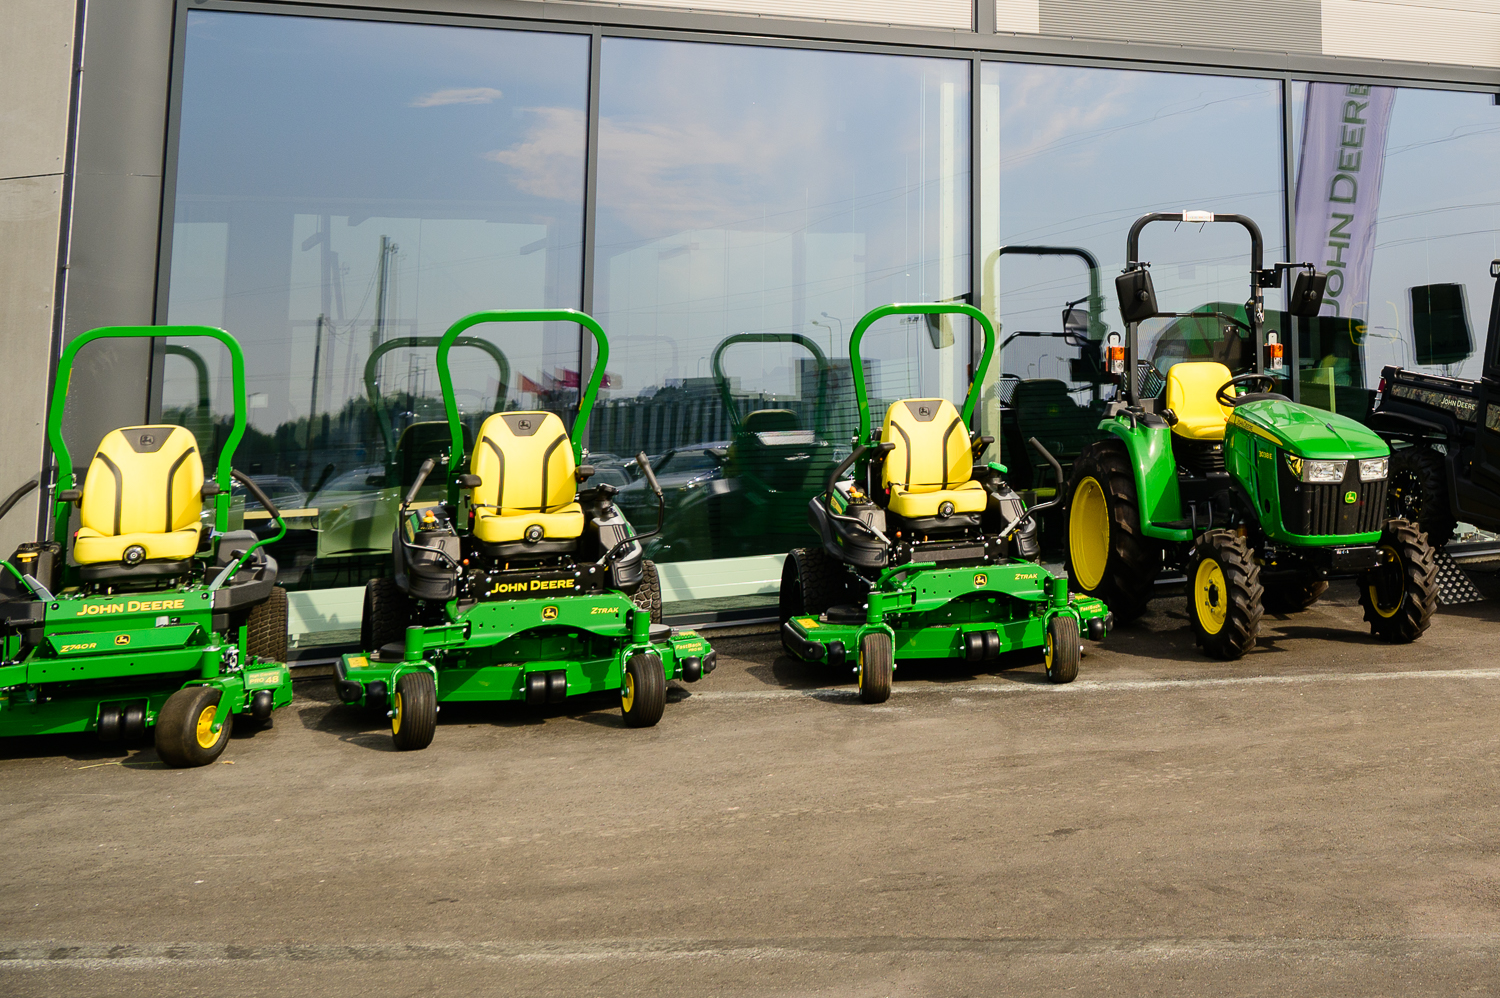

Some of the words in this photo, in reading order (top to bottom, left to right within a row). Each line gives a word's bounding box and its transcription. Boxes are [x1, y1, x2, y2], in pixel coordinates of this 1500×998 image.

[1320, 212, 1355, 318] JOHN
[1441, 397, 1457, 407] JOHN
[1457, 400, 1476, 411] DEERE
[1014, 573, 1038, 581] ZTRAK
[490, 582, 528, 594] JOHN
[530, 579, 575, 591] DEERE
[76, 603, 125, 616] JOHN
[127, 599, 185, 612] DEERE
[264, 675, 280, 684] 48
